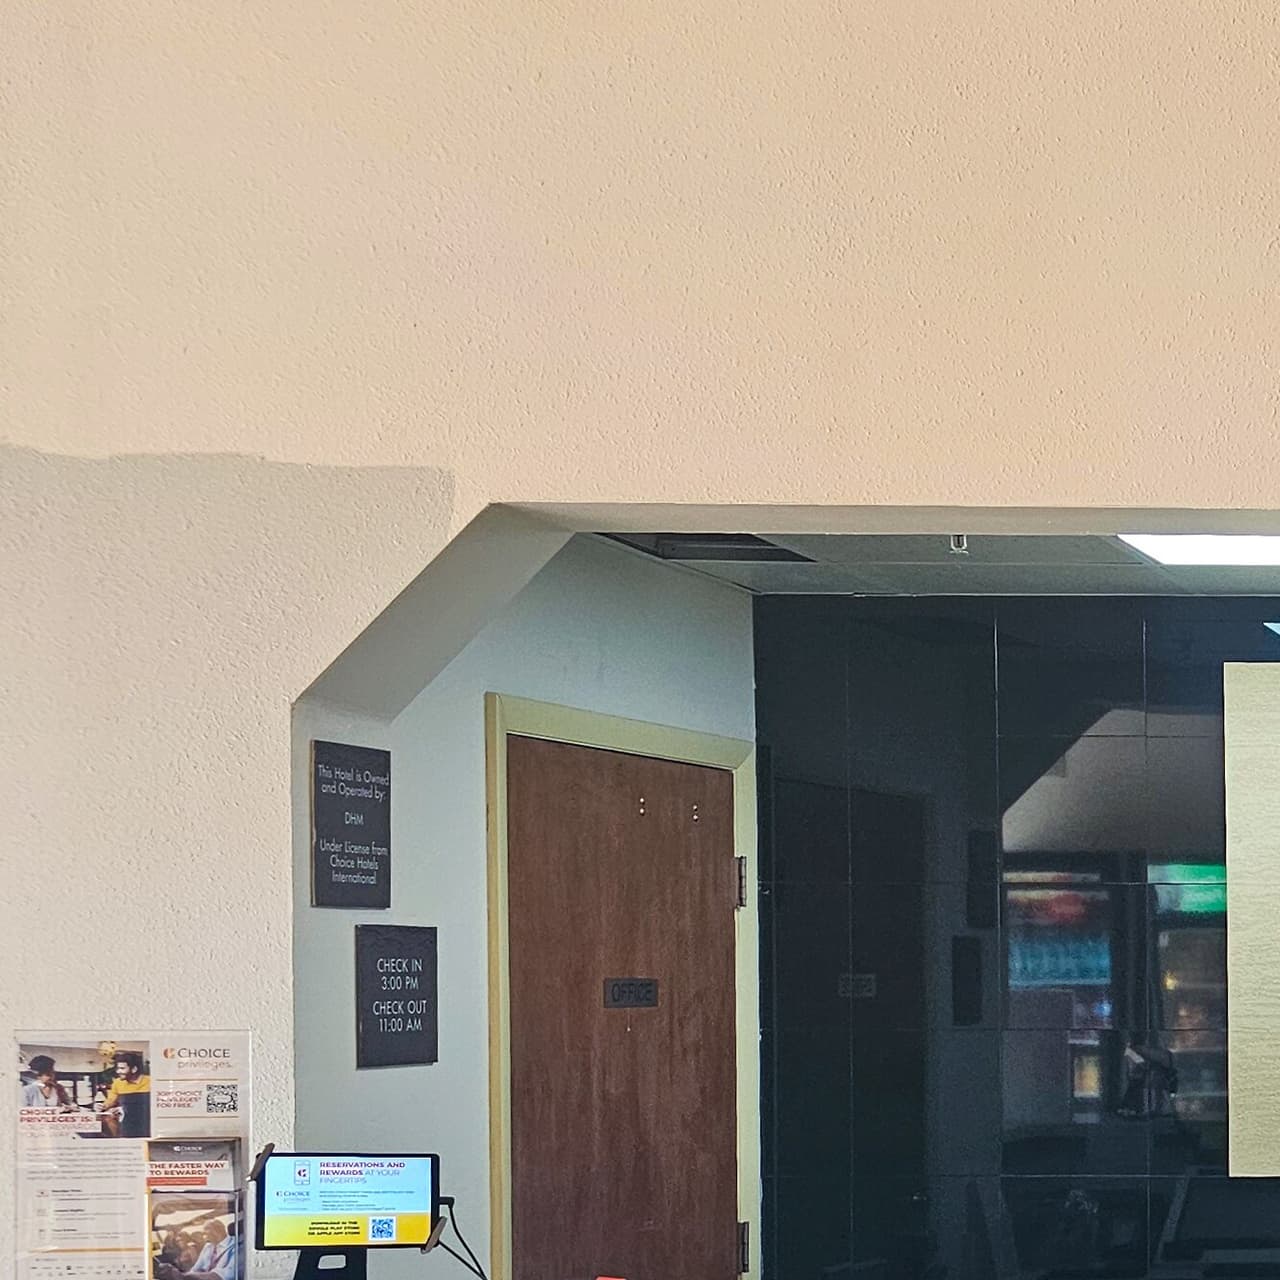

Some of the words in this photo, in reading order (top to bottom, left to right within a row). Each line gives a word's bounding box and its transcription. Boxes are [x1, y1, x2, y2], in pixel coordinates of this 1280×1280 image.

[318, 764, 332, 778] This
[334, 767, 354, 781] Hotel
[355, 769, 362, 782] is
[363, 770, 389, 786] Owned
[321, 781, 337, 794] and
[338, 782, 373, 799] Operated
[344, 812, 364, 825] DHM
[320, 838, 343, 852] Under
[344, 841, 370, 855] License
[371, 841, 389, 856] from
[330, 854, 355, 868] Choice
[357, 856, 379, 870] Hotels
[332, 870, 377, 884] International
[377, 958, 409, 972] CHECK
[412, 959, 423, 972] IN
[381, 976, 402, 990] 3:00
[405, 976, 419, 990] PM
[611, 983, 653, 1001] OFFICE
[372, 1001, 404, 1015] CHECK
[407, 1000, 427, 1014] OUT
[379, 1018, 403, 1032] 11:00
[406, 1018, 422, 1032] AM
[177, 1048, 231, 1058] CHOICE
